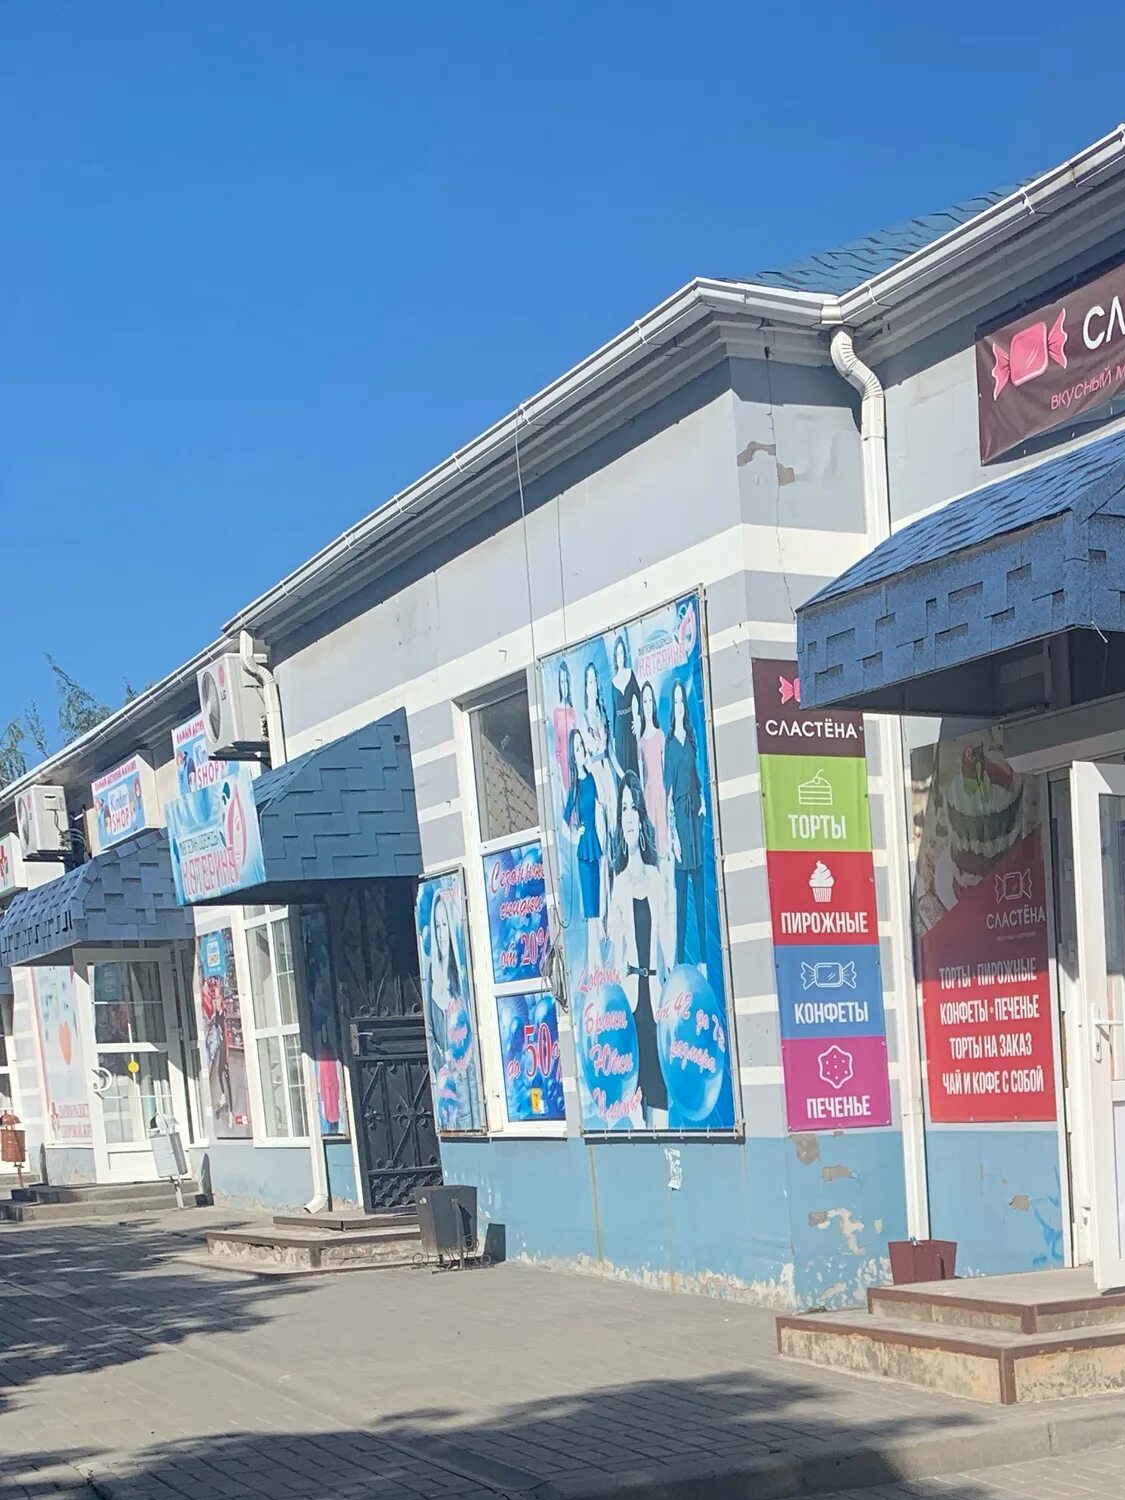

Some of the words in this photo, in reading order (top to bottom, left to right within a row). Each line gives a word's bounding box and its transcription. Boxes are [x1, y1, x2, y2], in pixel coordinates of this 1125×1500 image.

[765, 718, 857, 738] СЛАСТЁНА
[112, 808, 130, 833] SHOP
[788, 814, 847, 840] ТОРТЫ
[781, 912, 868, 934] ПИРОЖНЫЕ
[986, 904, 1046, 930] СЛАСТЁНА
[939, 964, 971, 989] ТОРТЫ
[977, 957, 1037, 984] ПИРОЖНЫЕ
[794, 1001, 868, 1024] КОНФЕТЫ
[939, 999, 988, 1025] КОНФЕТЫ
[994, 994, 1040, 1021] ПЕЧЕНЬЕ
[949, 1035, 982, 1060] ТОРТЫ
[984, 1034, 998, 1057] НА
[999, 1032, 1032, 1057] ЗАКАЗ
[942, 1068, 962, 1095] ЧАЙ
[963, 1070, 971, 1094] И
[972, 1069, 1000, 1094] КОФЕ
[1002, 1070, 1010, 1093] С
[1010, 1064, 1044, 1093] СОБОЙ
[806, 1095, 871, 1119] ПЕЧЕНЬЕ
